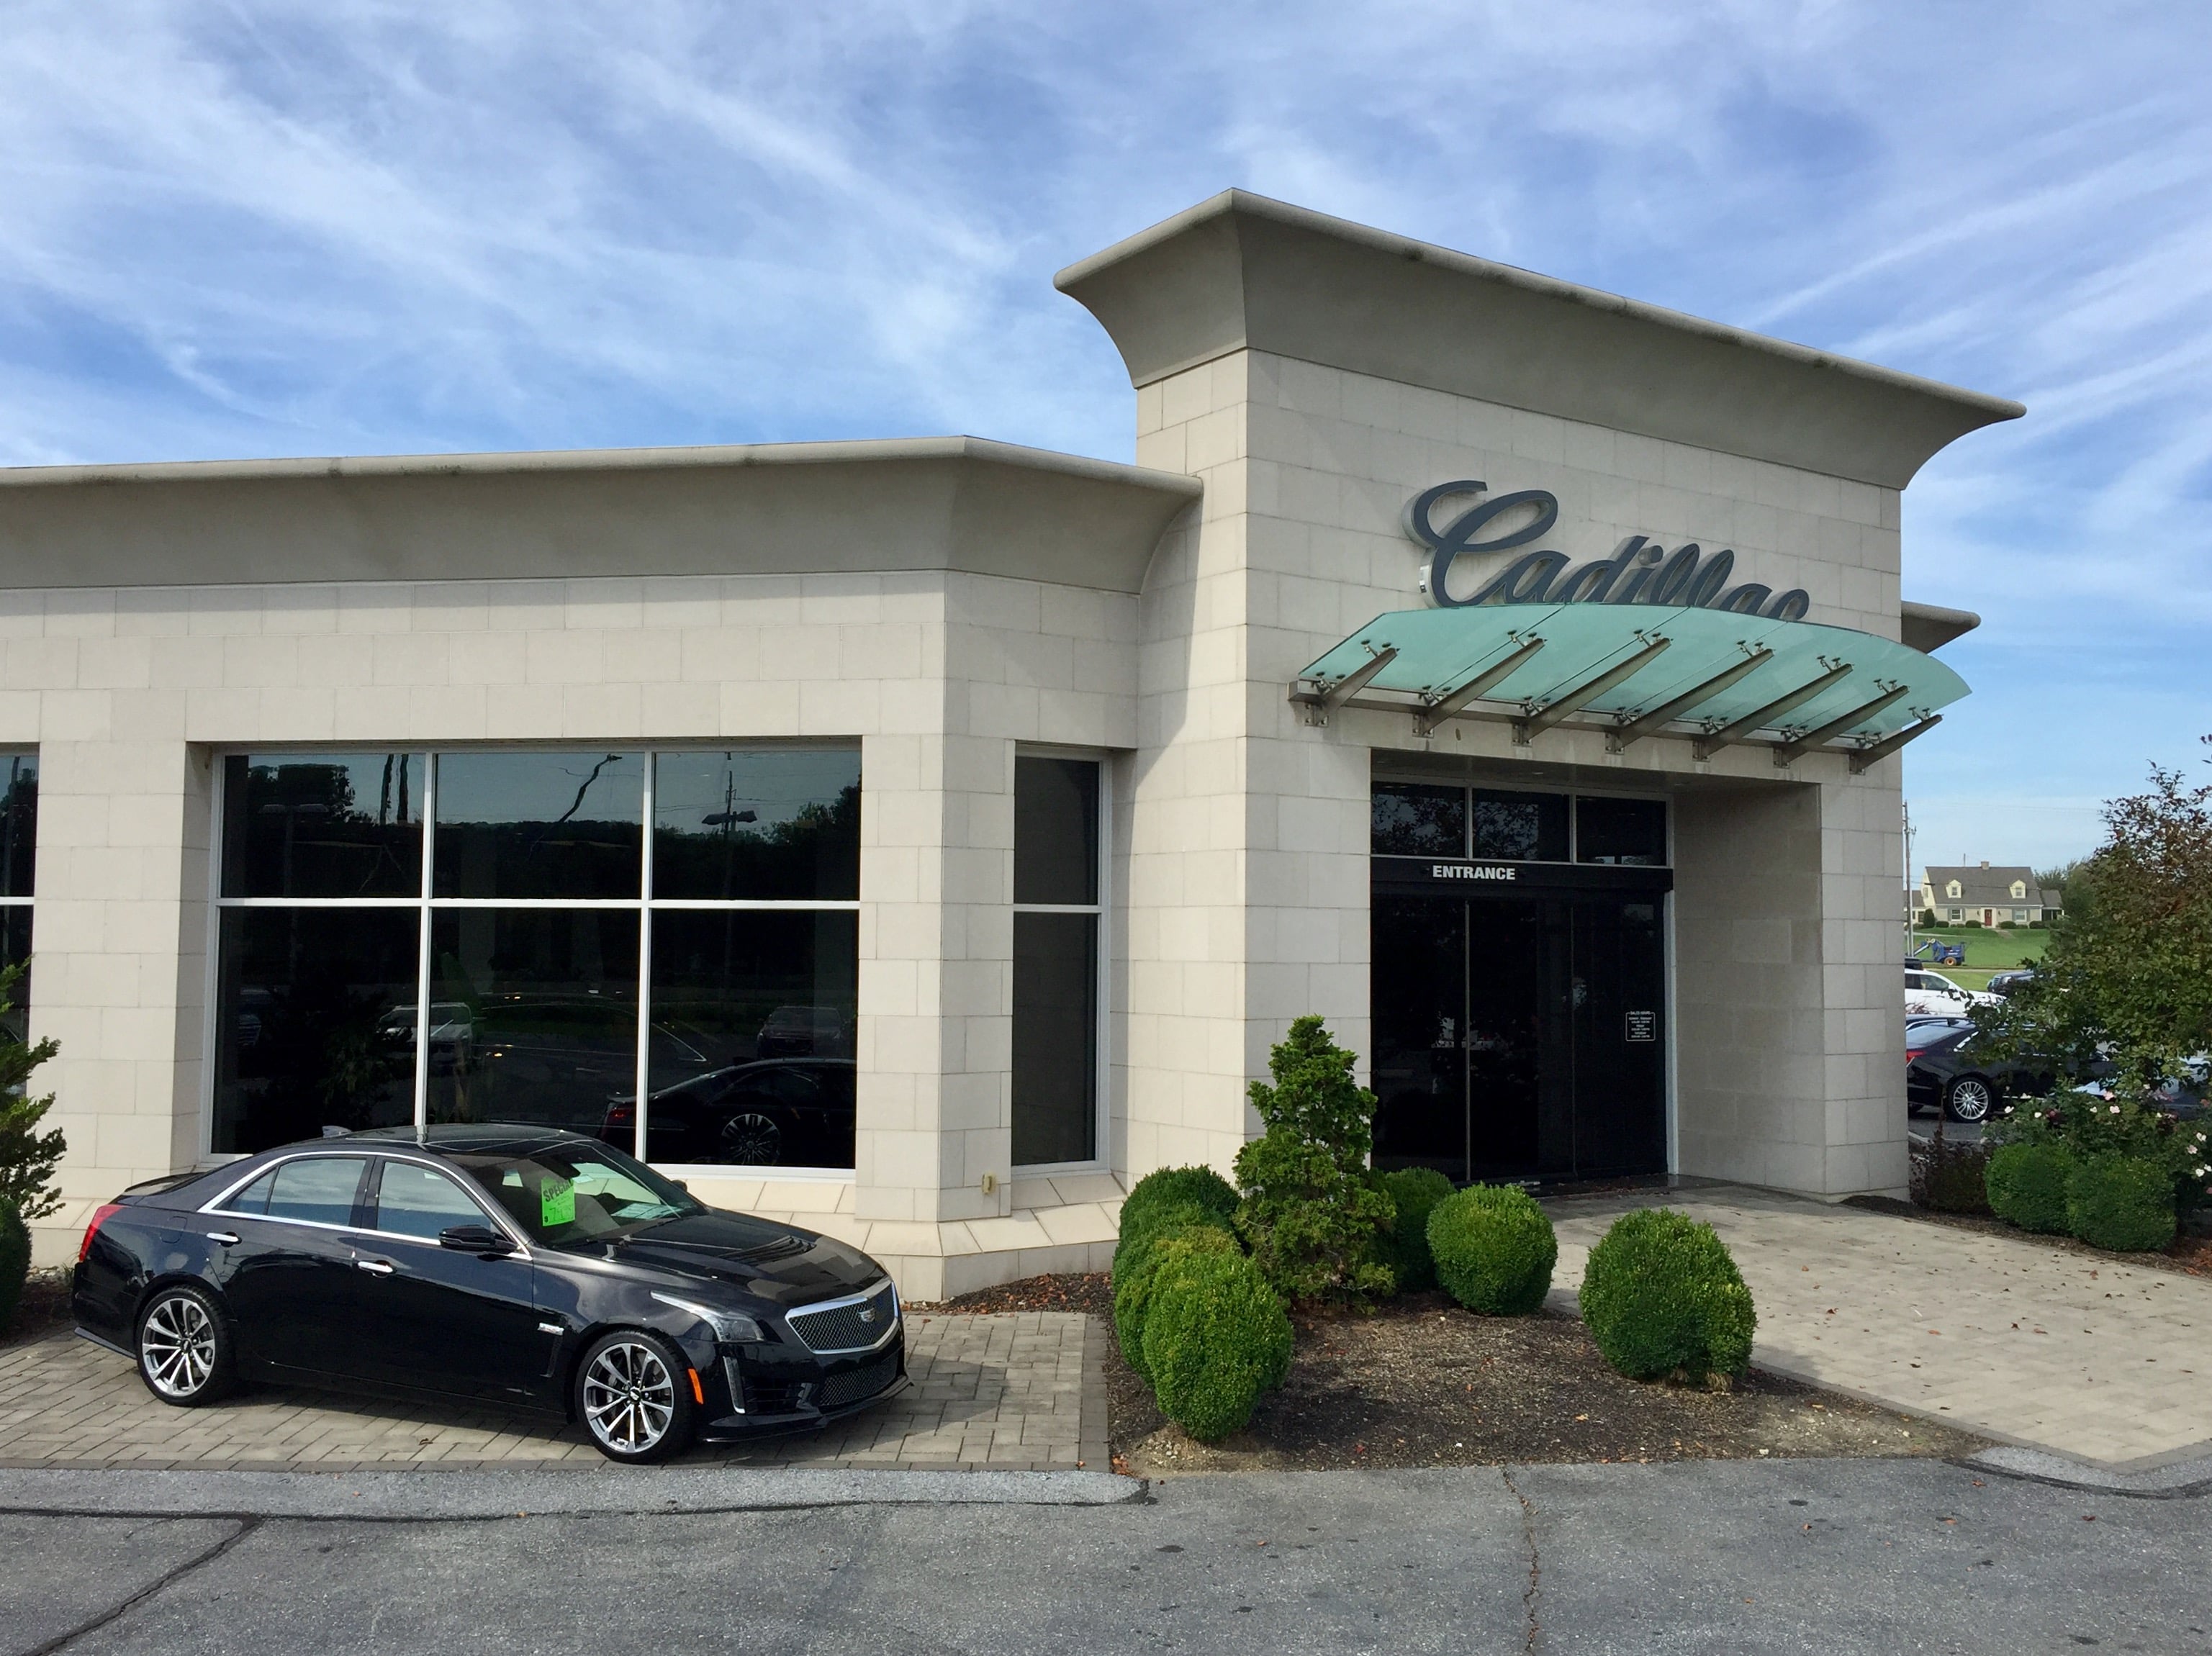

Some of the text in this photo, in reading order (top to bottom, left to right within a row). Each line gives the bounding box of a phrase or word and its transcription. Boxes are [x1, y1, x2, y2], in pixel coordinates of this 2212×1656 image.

[1403, 480, 1810, 621] Cadillac
[1432, 865, 1515, 879] ENTRANCE
[543, 1178, 574, 1202] SPECIAL
